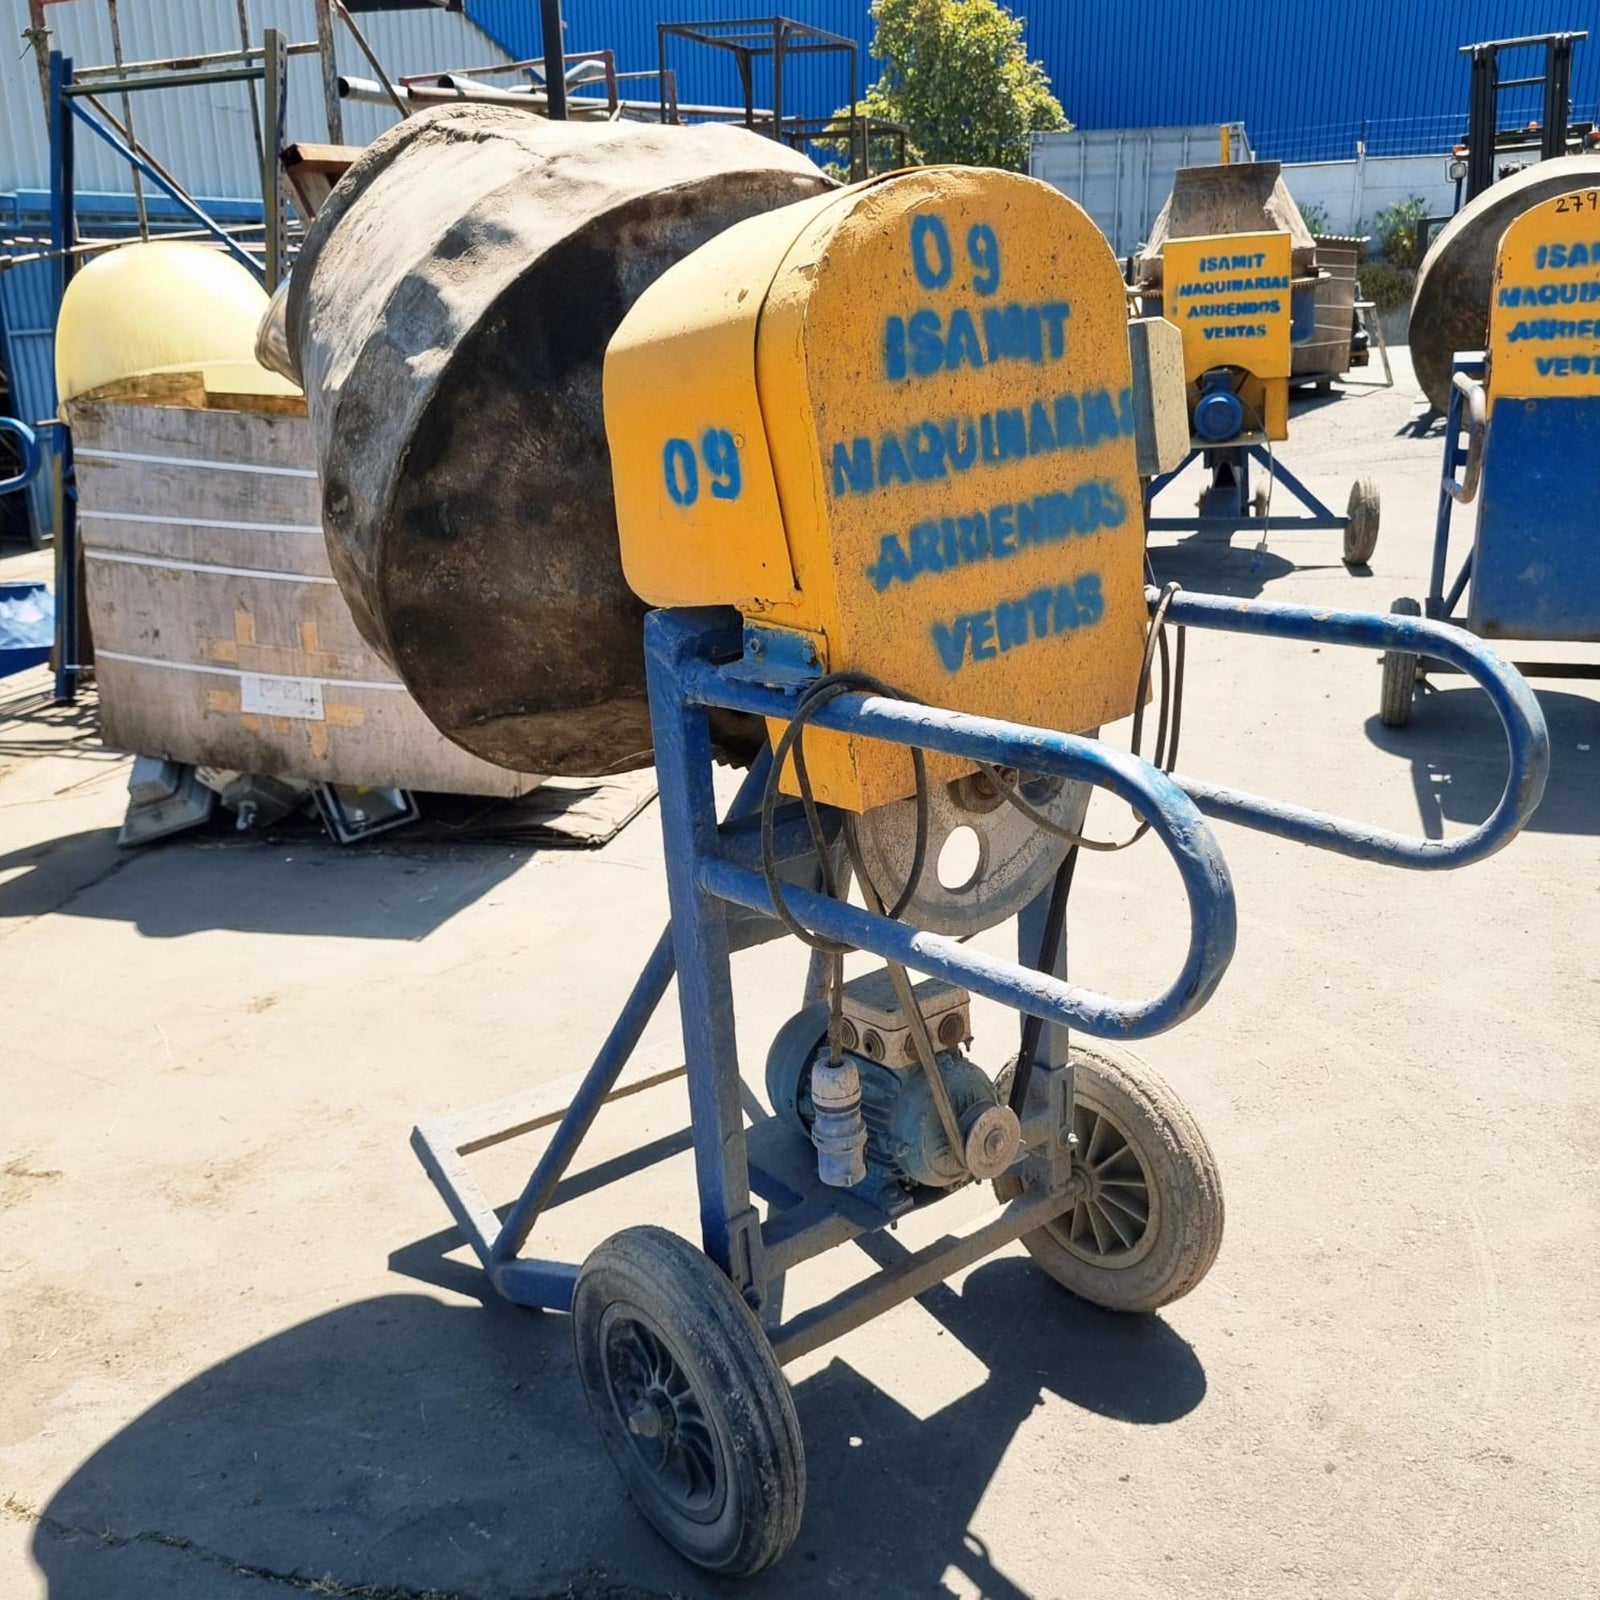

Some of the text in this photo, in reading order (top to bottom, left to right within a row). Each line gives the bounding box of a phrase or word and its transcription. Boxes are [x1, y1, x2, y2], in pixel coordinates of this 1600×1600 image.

[1555, 191, 1598, 213] 279
[1199, 253, 1265, 272] ISAMIT
[1179, 276, 1290, 297] MAQUINARIAS
[1187, 299, 1281, 319] ARRIENDOS
[884, 302, 1071, 382] ISAMIT
[1203, 324, 1266, 340] VENTAS
[663, 426, 742, 507] 09
[931, 573, 1105, 674] VENTAS
